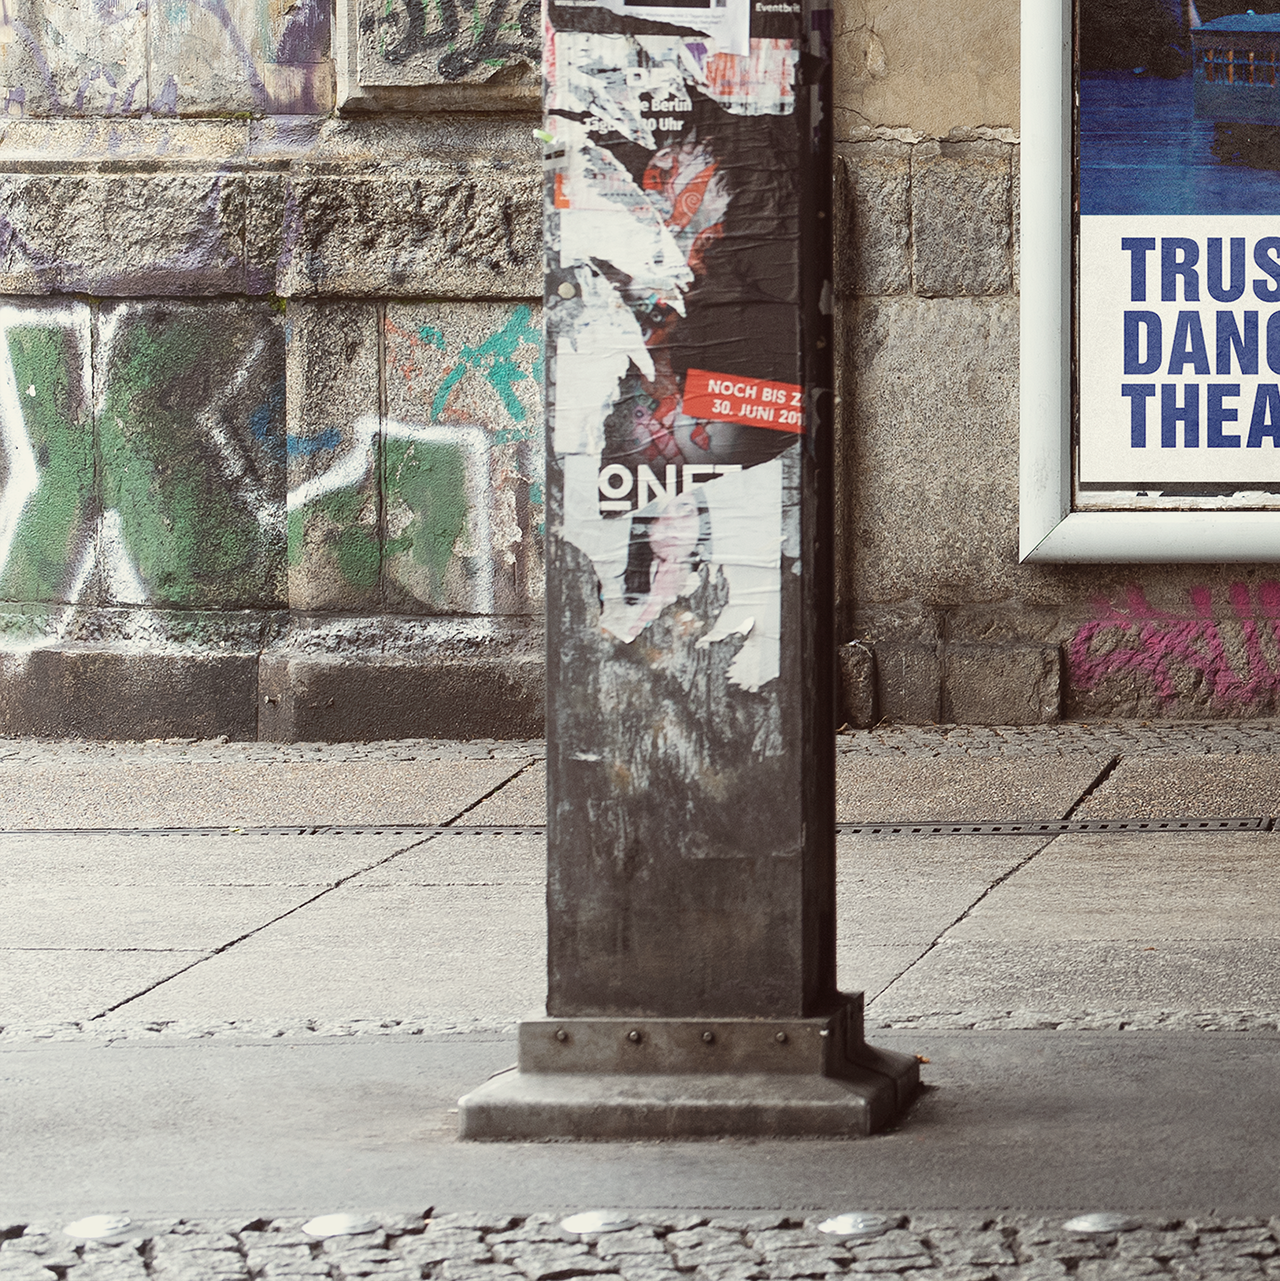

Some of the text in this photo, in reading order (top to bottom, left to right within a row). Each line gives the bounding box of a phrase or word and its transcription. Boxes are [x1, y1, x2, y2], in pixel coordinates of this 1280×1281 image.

[659, 118, 684, 131] Uhr
[708, 379, 786, 404] NOCH BIS
[711, 399, 734, 416] 30.
[738, 402, 774, 422] JUNI
